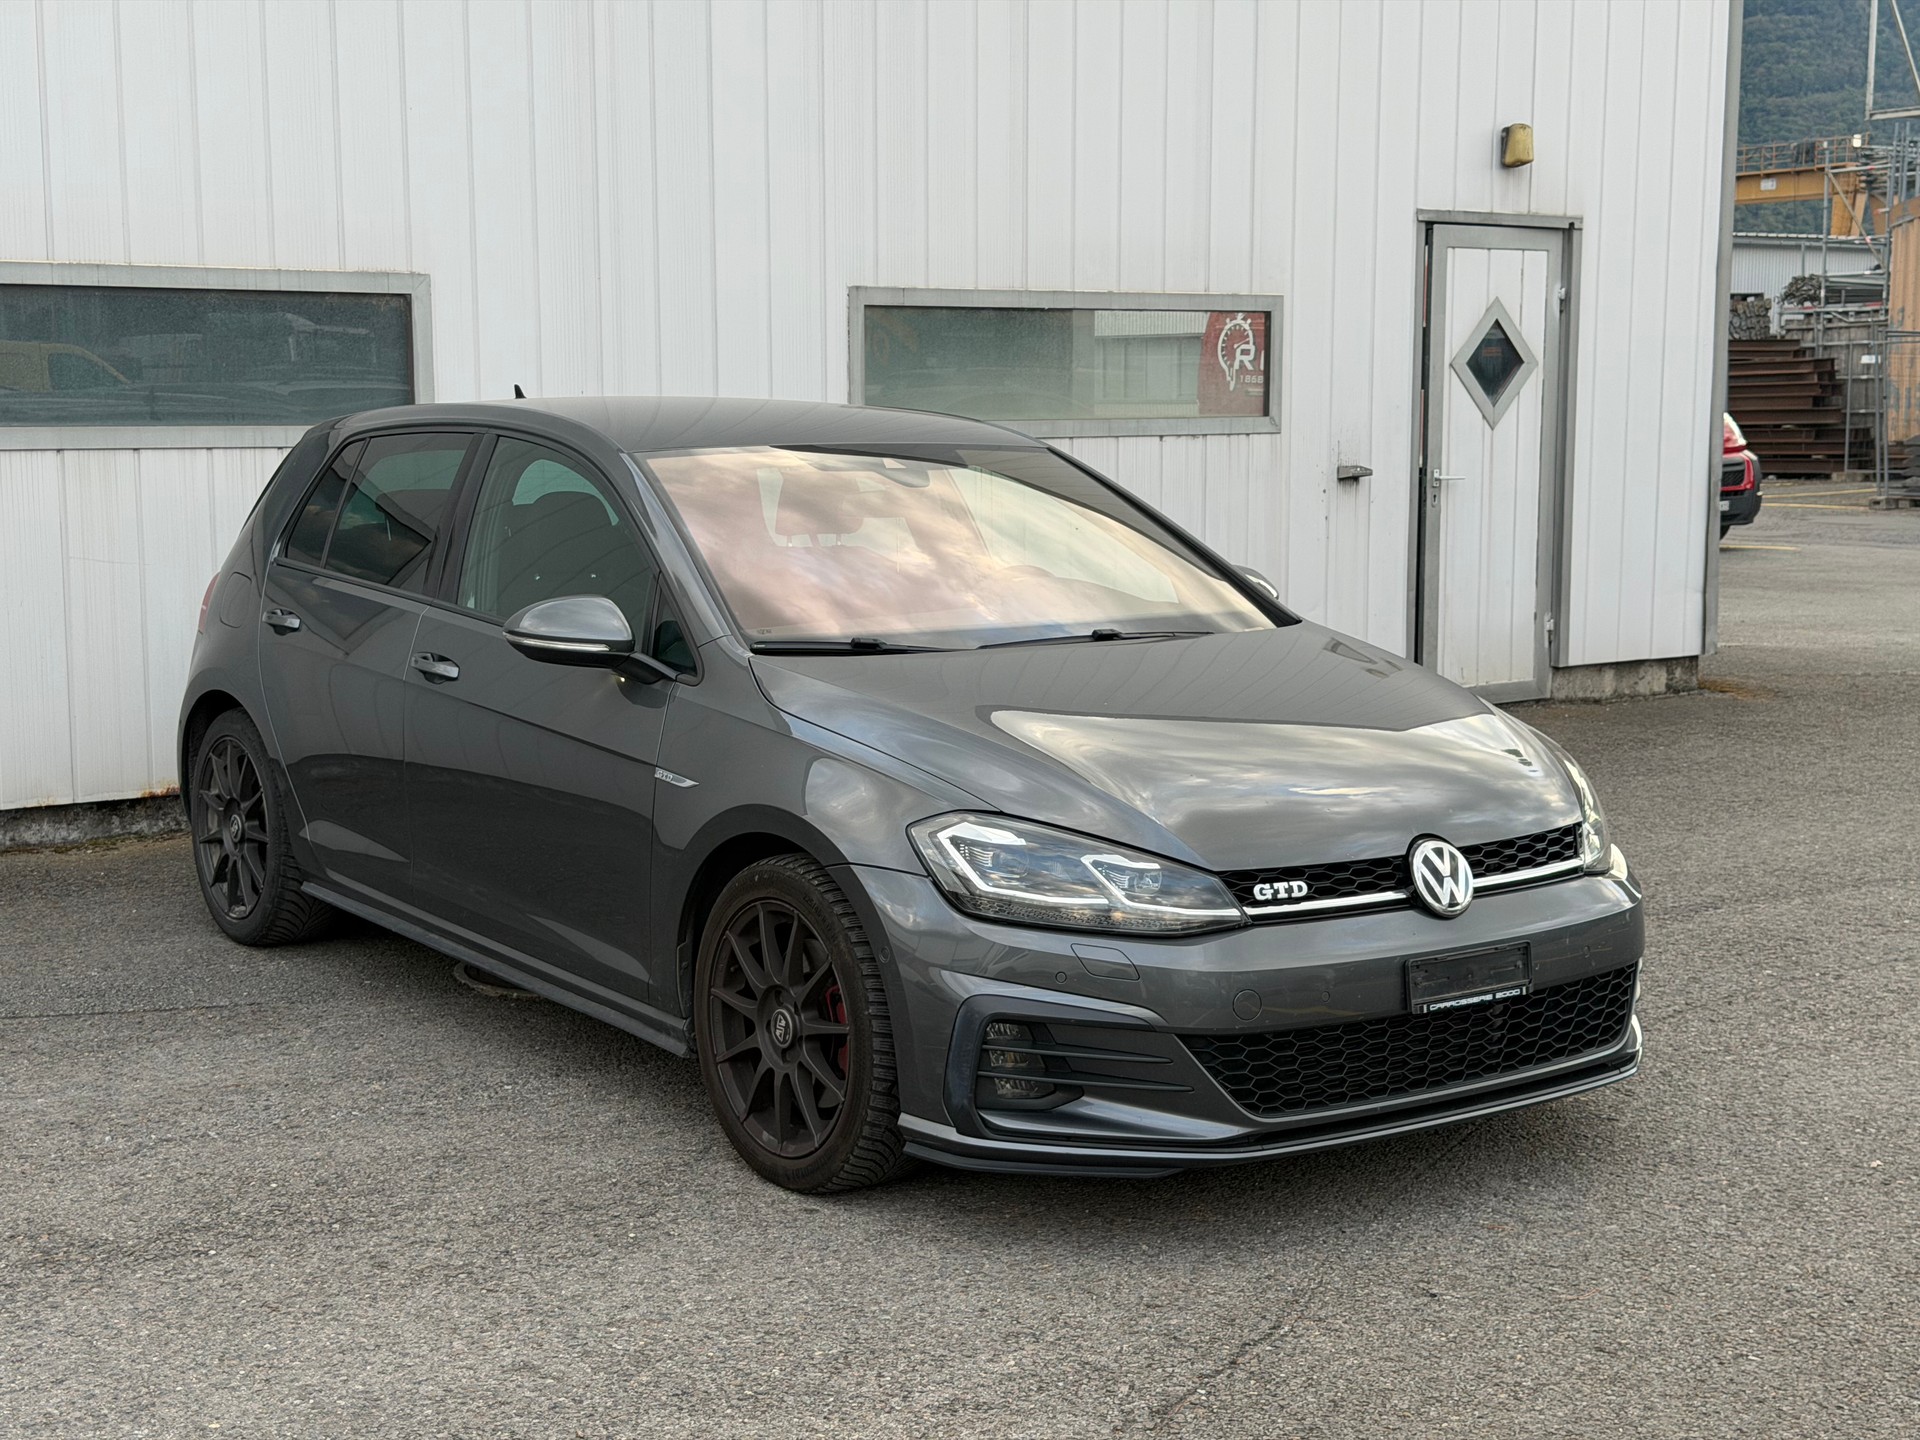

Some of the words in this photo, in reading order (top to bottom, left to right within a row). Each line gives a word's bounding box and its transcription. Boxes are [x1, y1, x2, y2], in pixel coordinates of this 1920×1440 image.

[1413, 840, 1473, 912] VW
[1253, 880, 1308, 901] GTD
[1495, 988, 1521, 999] 2000
